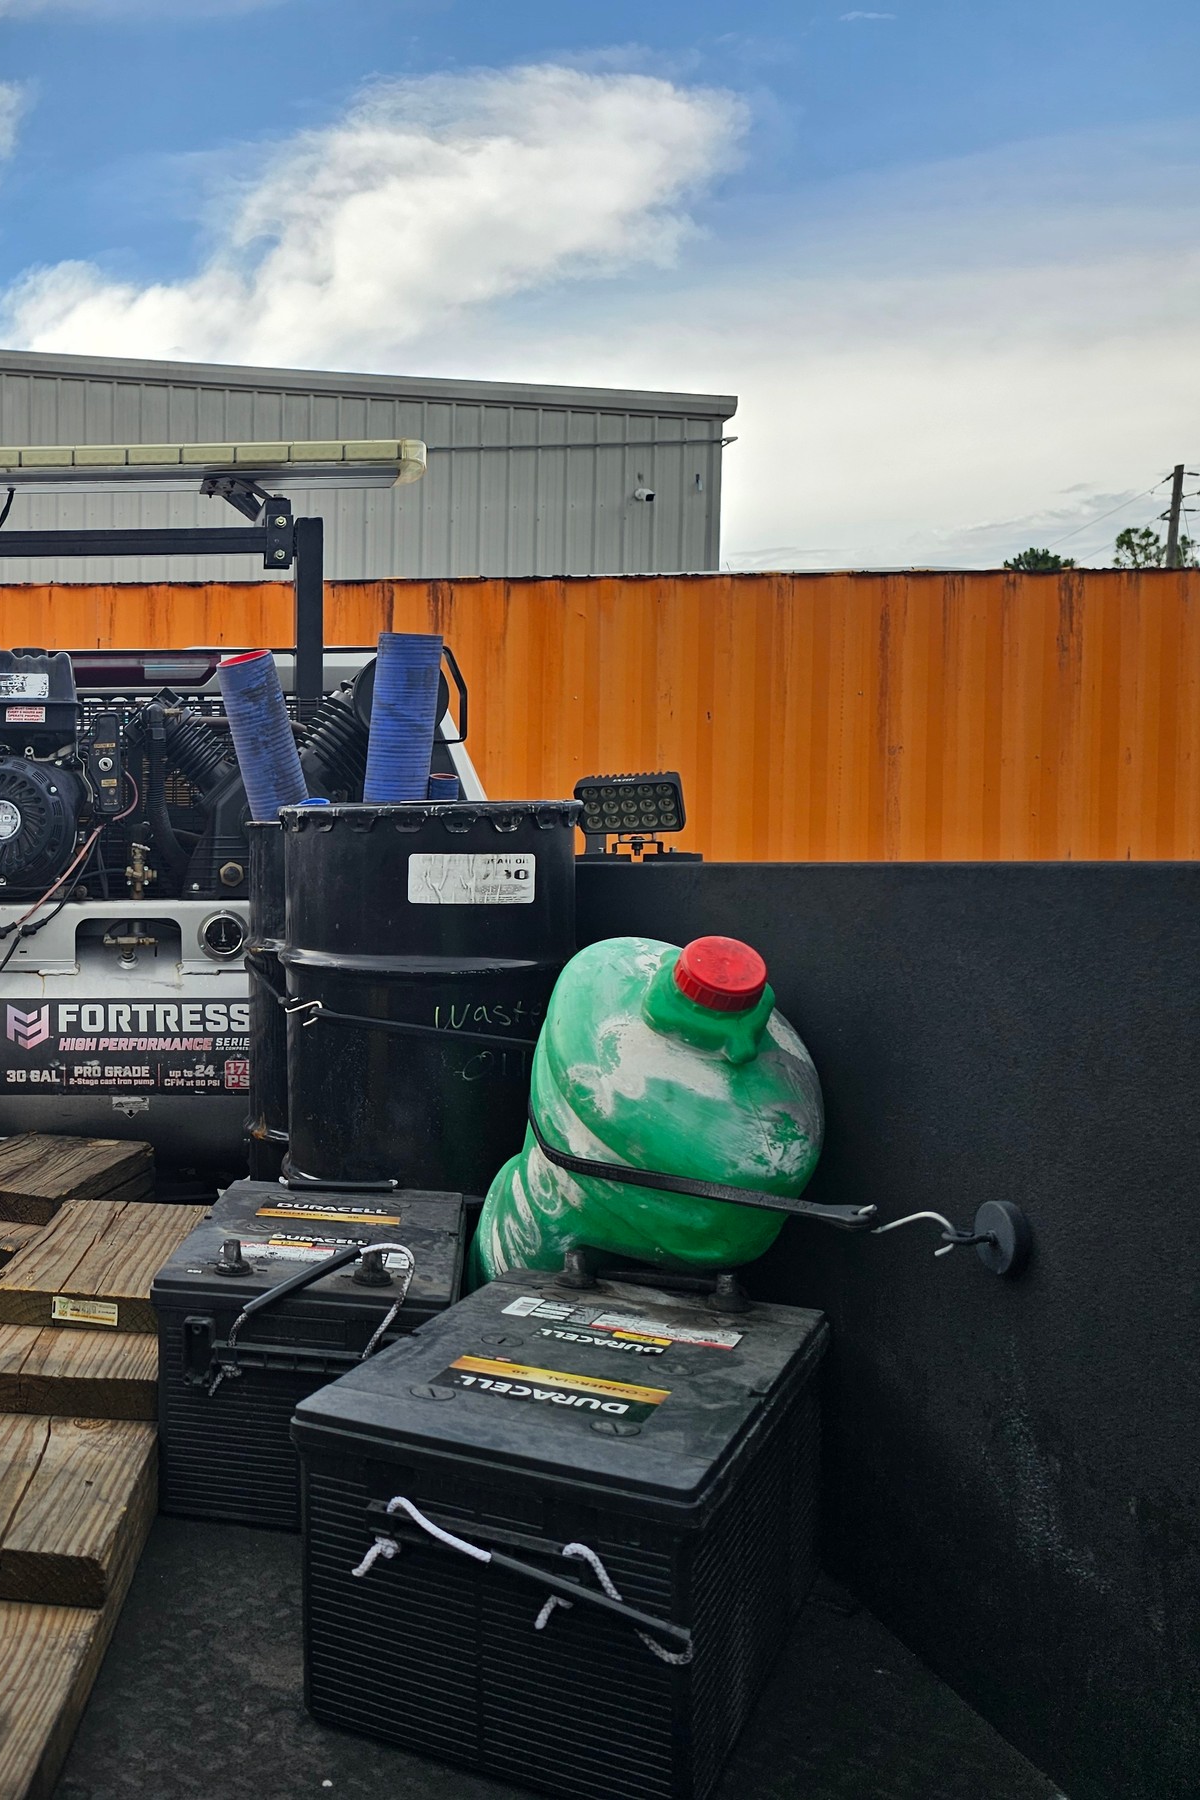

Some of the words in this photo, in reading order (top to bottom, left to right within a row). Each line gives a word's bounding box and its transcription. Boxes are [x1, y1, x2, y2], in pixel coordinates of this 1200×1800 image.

[58, 1004, 250, 1032] FORTRESS
[58, 1037, 98, 1051] HIGH
[98, 1037, 213, 1051] PERFORMANCE
[215, 1037, 250, 1046] SERIE
[6, 1070, 26, 1082] 30
[29, 1070, 61, 1082] GAL
[73, 1065, 101, 1077] PRO
[104, 1065, 150, 1077] GRADE
[169, 1070, 181, 1078] up
[194, 1064, 215, 1077] 24
[69, 1078, 99, 1086] 2-Stage
[133, 1078, 154, 1086] pump
[164, 1079, 185, 1087] CFM
[207, 1079, 220, 1087] PSI
[227, 1075, 250, 1086] PS
[276, 1202, 389, 1215] DURACELL
[271, 1233, 369, 1246] DURACELL
[540, 1327, 665, 1354] DURACELL
[549, 1374, 650, 1397] COMMERCIAL
[460, 1374, 631, 1415] DURACELL
